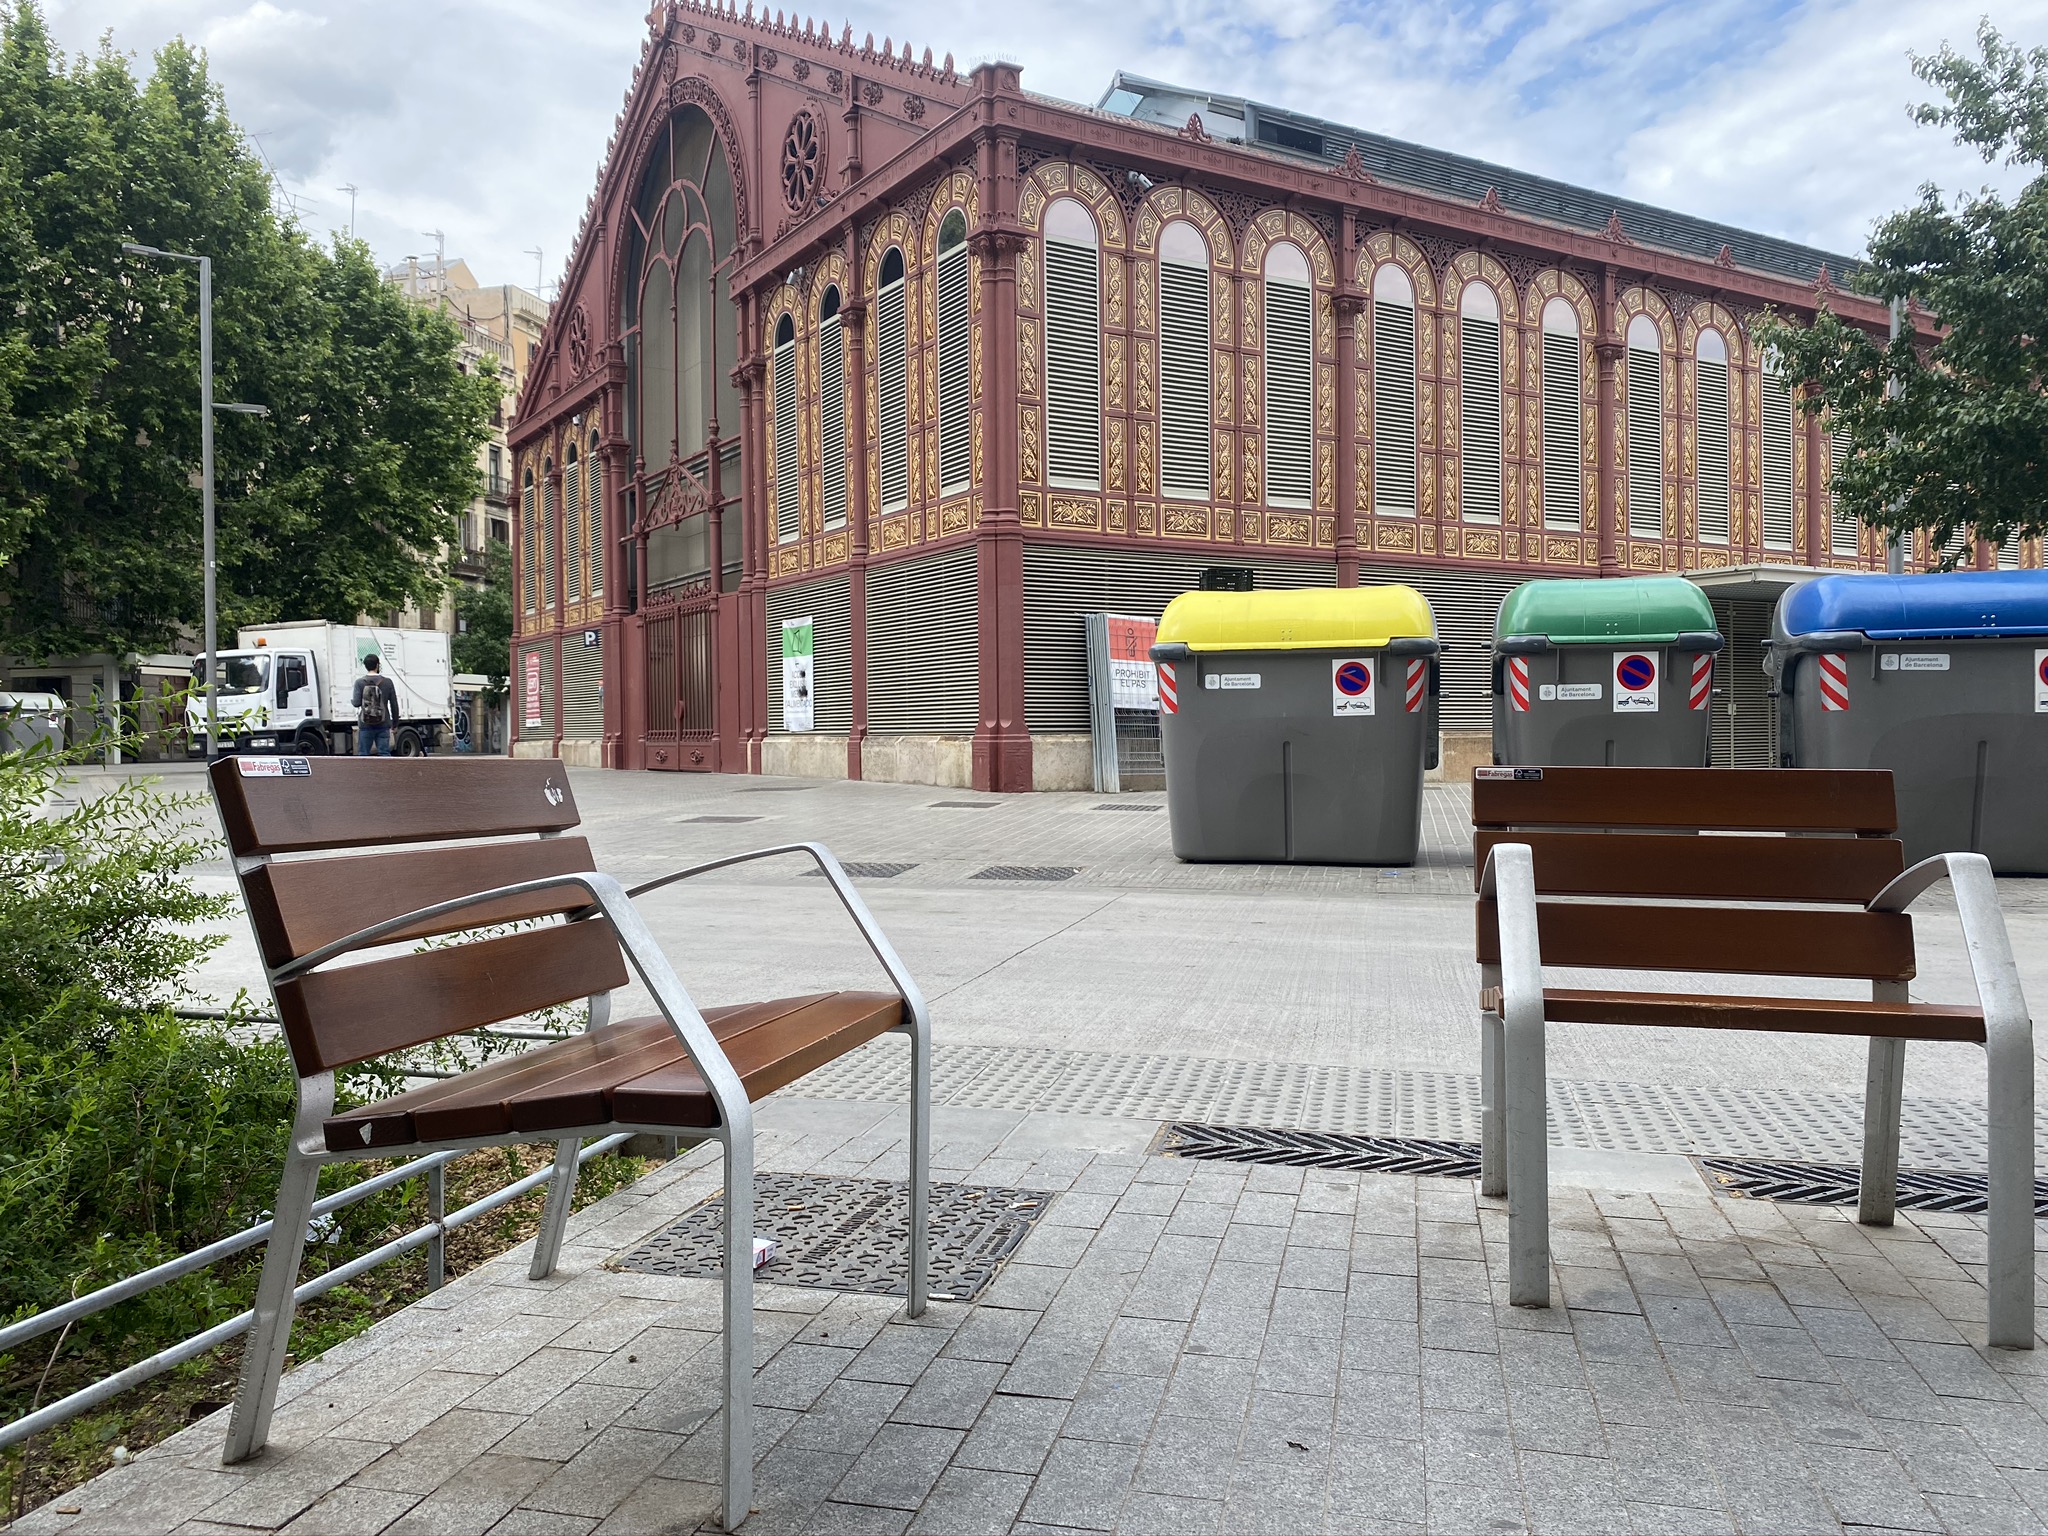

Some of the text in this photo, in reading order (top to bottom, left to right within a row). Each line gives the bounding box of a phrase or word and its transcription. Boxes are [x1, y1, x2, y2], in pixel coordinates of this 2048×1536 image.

[1115, 668, 1150, 679] PROHIBIT
[1120, 679, 1147, 688] EL PAS
[252, 762, 281, 773] Fabregas
[1487, 770, 1513, 778] Fabregas
